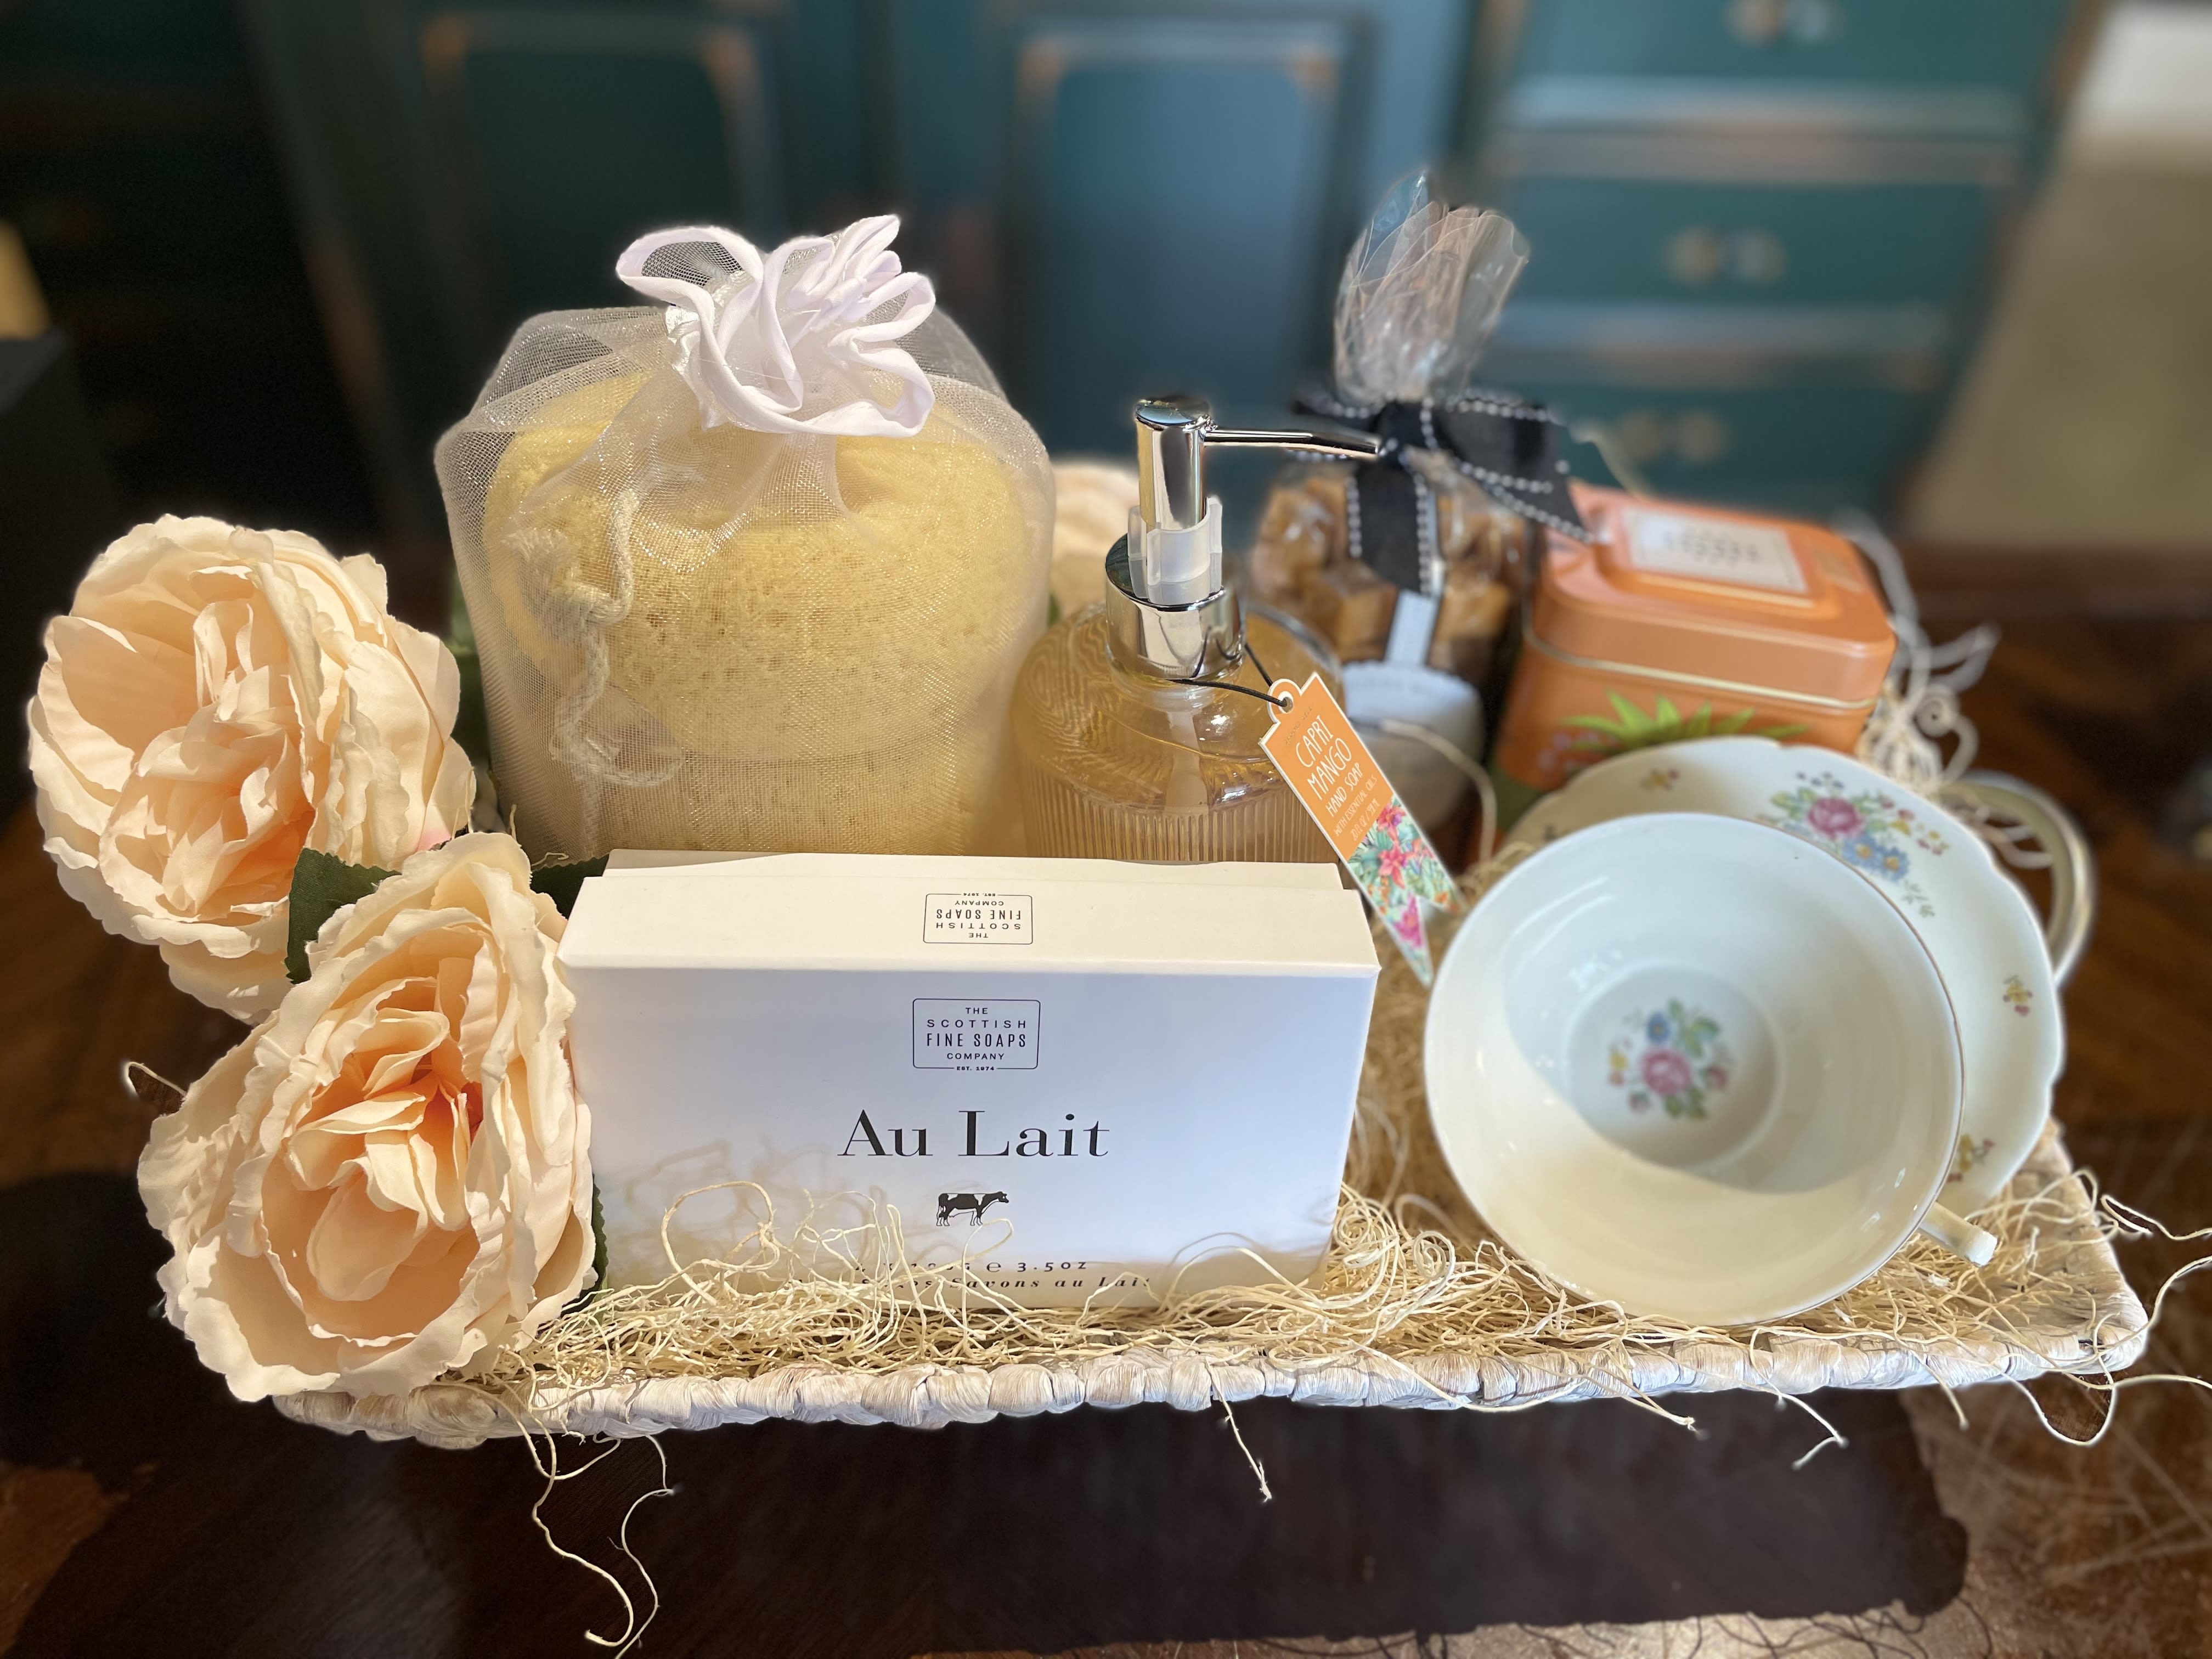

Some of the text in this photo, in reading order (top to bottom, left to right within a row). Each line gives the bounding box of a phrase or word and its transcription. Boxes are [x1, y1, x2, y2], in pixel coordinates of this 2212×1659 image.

[1296, 715, 1334, 768] CAPRI
[1307, 738, 1352, 800] MANGO
[1325, 762, 1364, 817] HAND SOAP
[1334, 774, 1378, 836] WITH ESSENTIAL OILS
[936, 909, 1021, 920] FINE SOAPS
[927, 1019, 1026, 1029] SCOTTISH
[927, 1033, 1026, 1047] FINE SOAPS
[837, 1109, 1110, 1156] Au Lait
